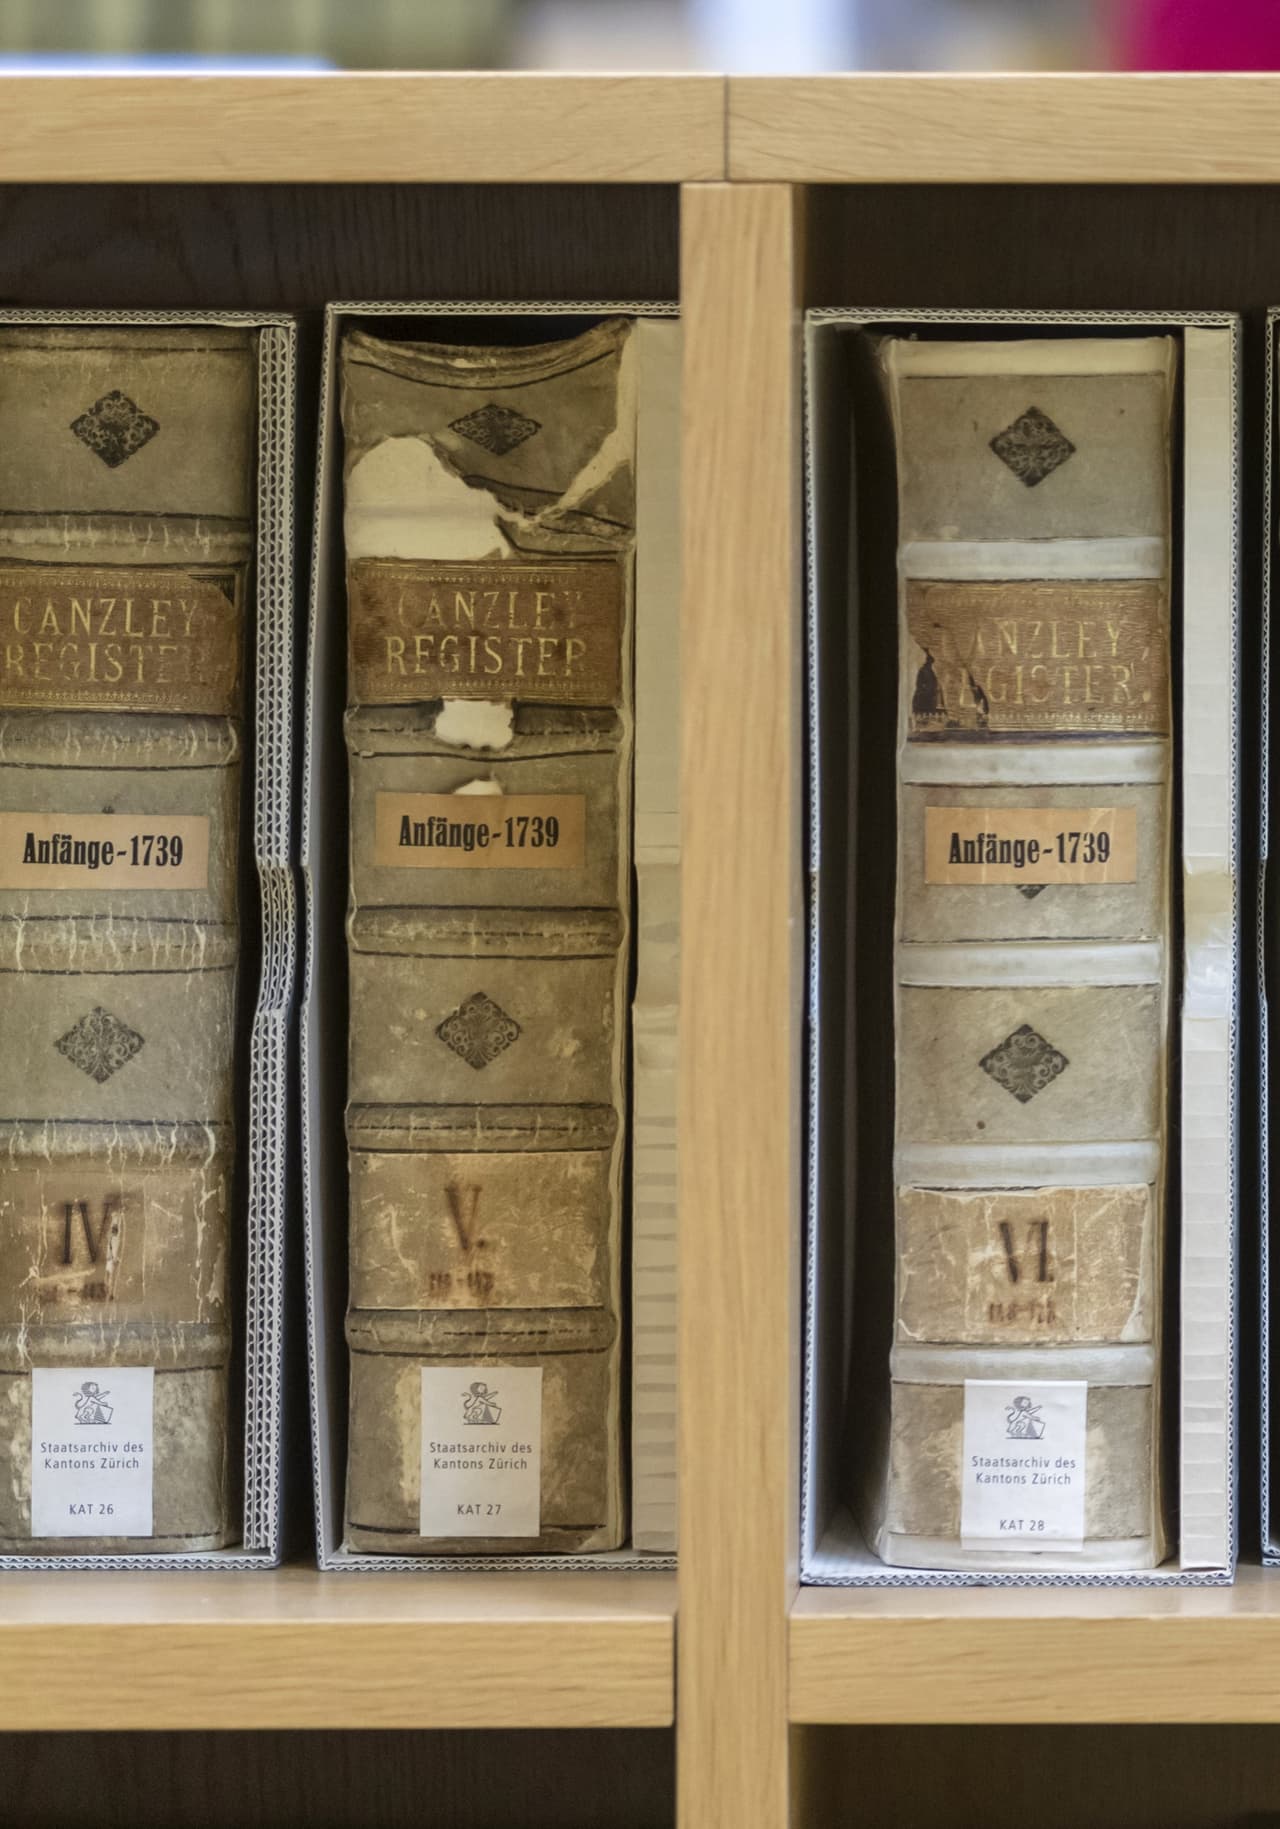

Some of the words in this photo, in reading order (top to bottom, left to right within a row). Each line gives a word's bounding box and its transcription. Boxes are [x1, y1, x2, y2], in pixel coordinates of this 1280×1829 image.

[14, 597, 198, 637] CANZLEY
[940, 617, 1120, 660] ANZLEY
[400, 816, 559, 851] Anfänge-1739
[23, 833, 183, 869] Anfänge-1739
[948, 832, 1110, 868] Anfänge-1739
[41, 1441, 118, 1453] Staatsarchiv
[123, 1441, 144, 1453] des
[429, 1441, 506, 1454] Staatsarchiv
[511, 1441, 532, 1454] des
[45, 1457, 95, 1470] Kantons
[100, 1457, 139, 1470] Zürich
[434, 1457, 484, 1470] Kantons
[489, 1457, 527, 1470] Zürich
[971, 1455, 1050, 1469] Staatsarchiv
[1055, 1455, 1076, 1469] des
[976, 1472, 1026, 1485] Kantons
[1031, 1471, 1071, 1485] Zürich
[69, 1503, 94, 1516] KAT
[99, 1503, 114, 1516] 26
[457, 1503, 481, 1516] KAT
[486, 1503, 501, 1516] 27
[1000, 1519, 1026, 1532] KAT
[1030, 1519, 1045, 1532] 28
